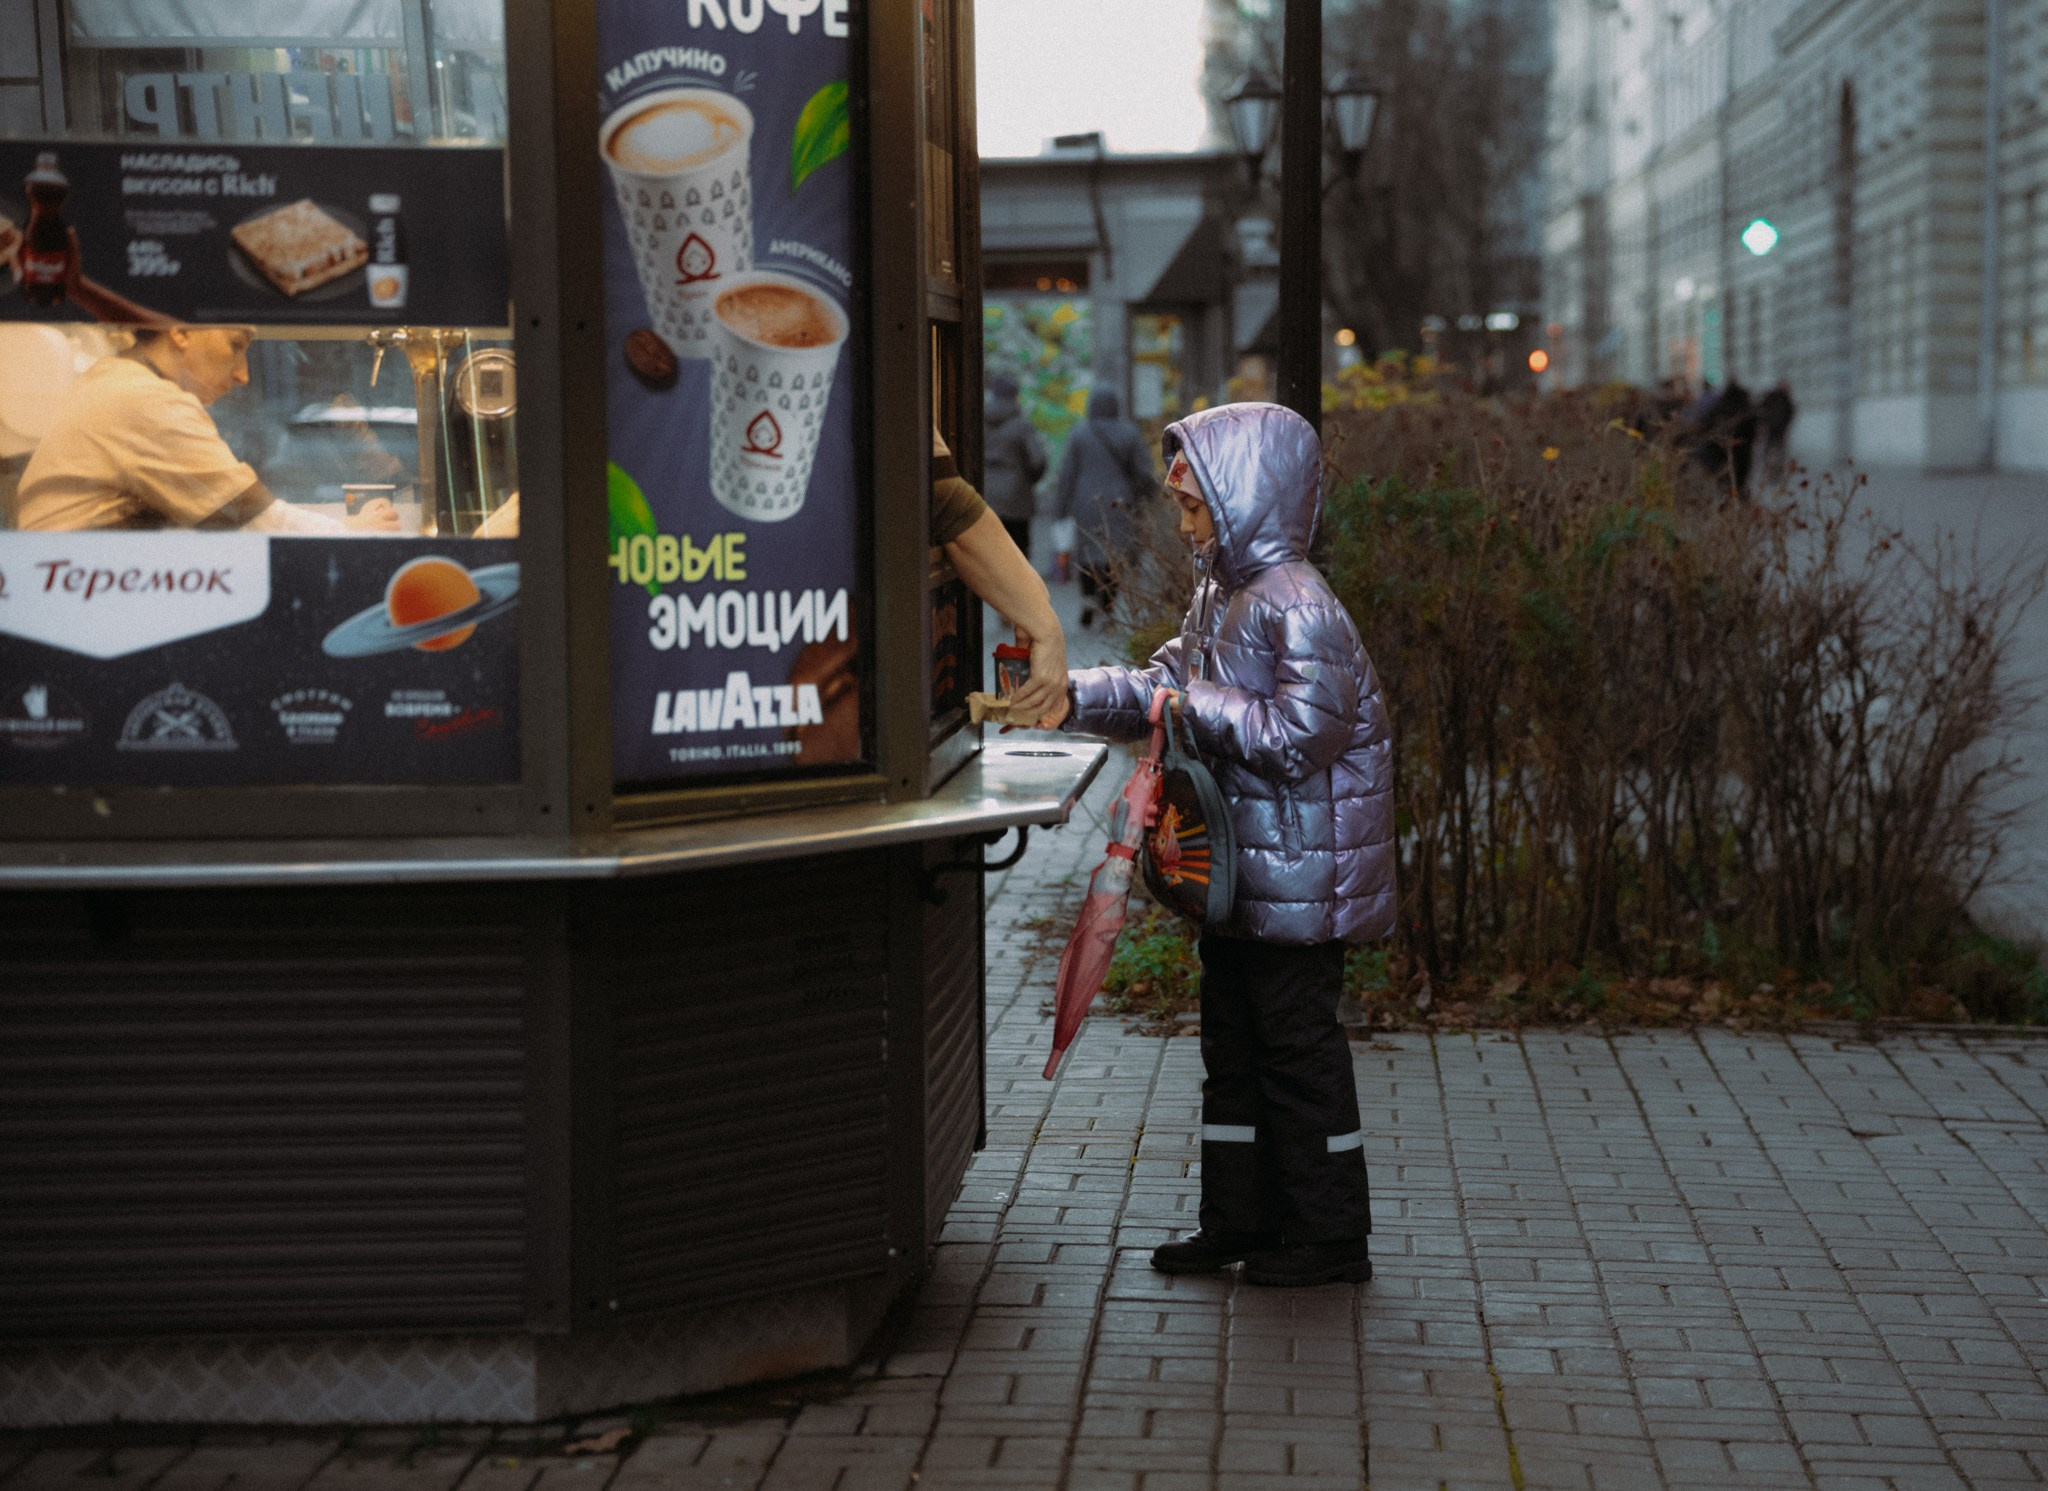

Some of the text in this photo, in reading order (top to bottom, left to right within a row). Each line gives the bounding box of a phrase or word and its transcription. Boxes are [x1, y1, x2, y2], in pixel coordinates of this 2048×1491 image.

[605, 46, 727, 92] КАПУЧИНО
[768, 239, 852, 287] АМЕРИКАНО
[36, 559, 232, 601] Теремок
[648, 588, 849, 653] ЭМОЦИИ
